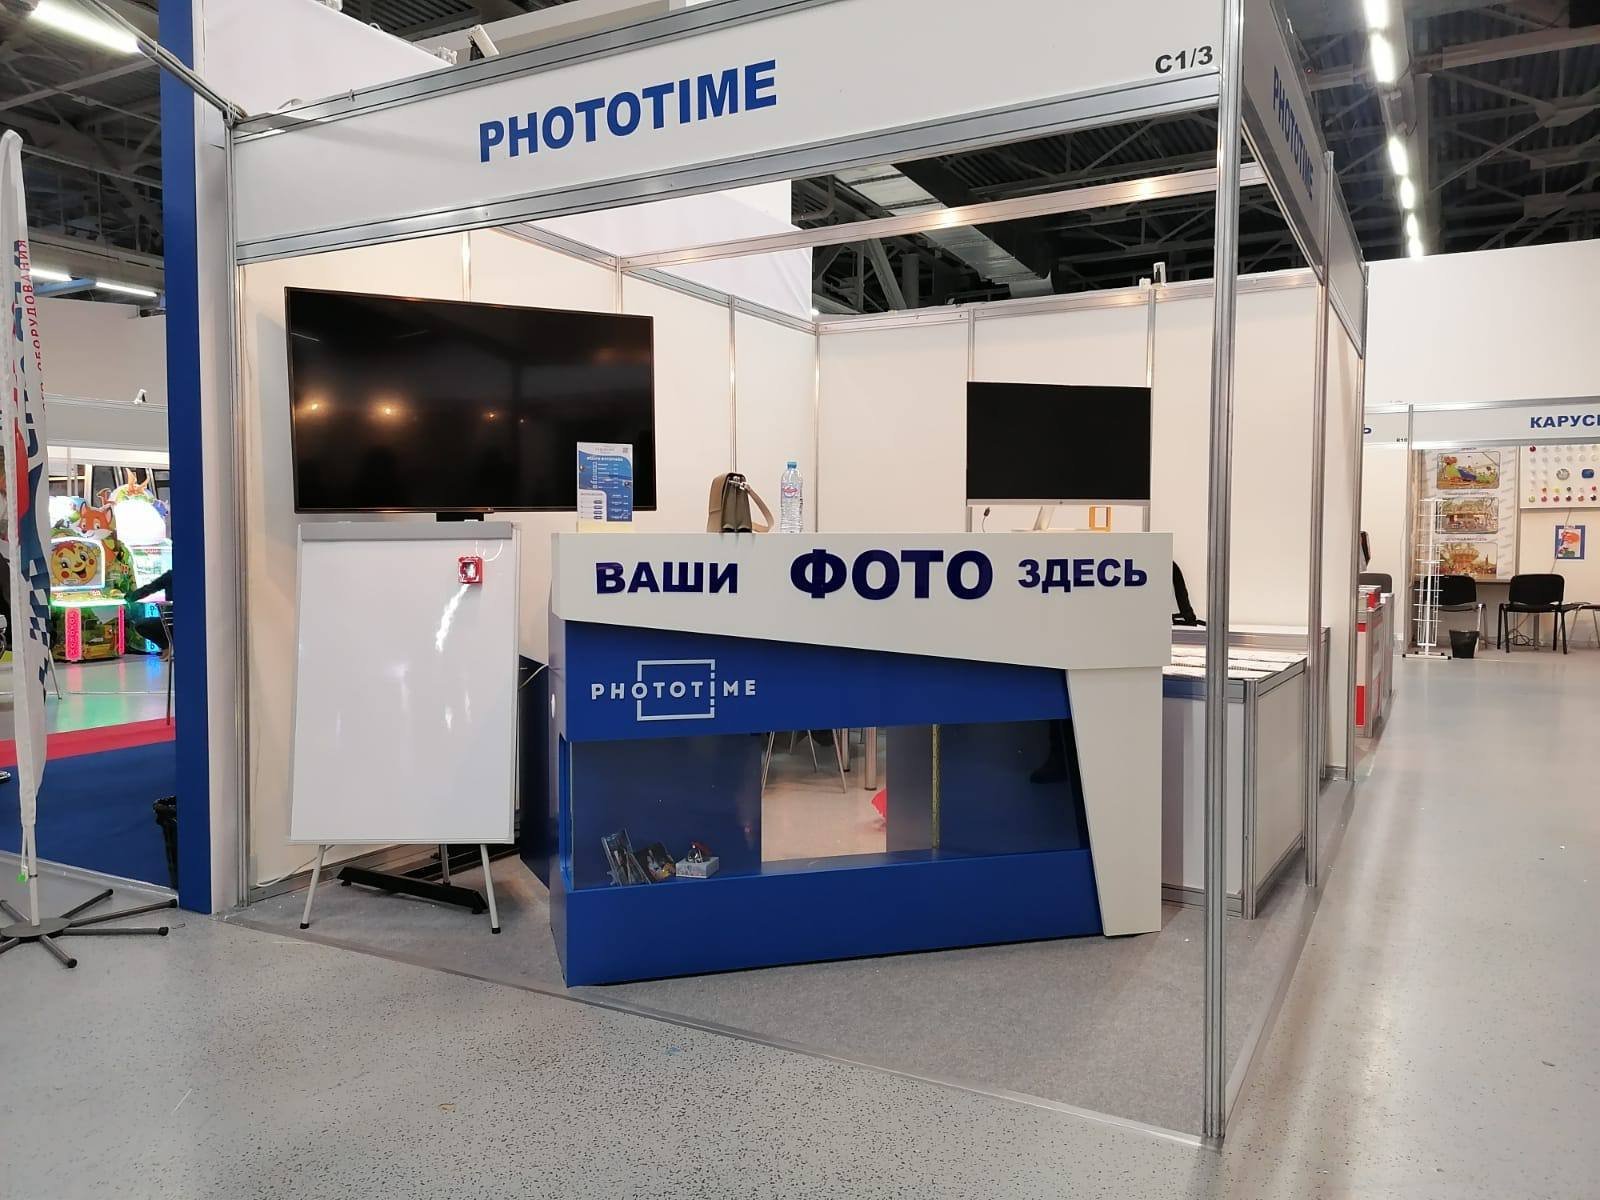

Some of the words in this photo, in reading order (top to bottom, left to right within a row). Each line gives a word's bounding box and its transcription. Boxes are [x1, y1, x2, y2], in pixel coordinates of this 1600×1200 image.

[480, 59, 777, 163] PHOTOTIME
[1273, 65, 1314, 200] PHOTOTIME
[596, 561, 738, 594] ВАШИ
[790, 549, 993, 600] ФОТО
[1018, 558, 1148, 593] ЗДЕСЬ
[591, 680, 756, 700] PHOTOTIME
